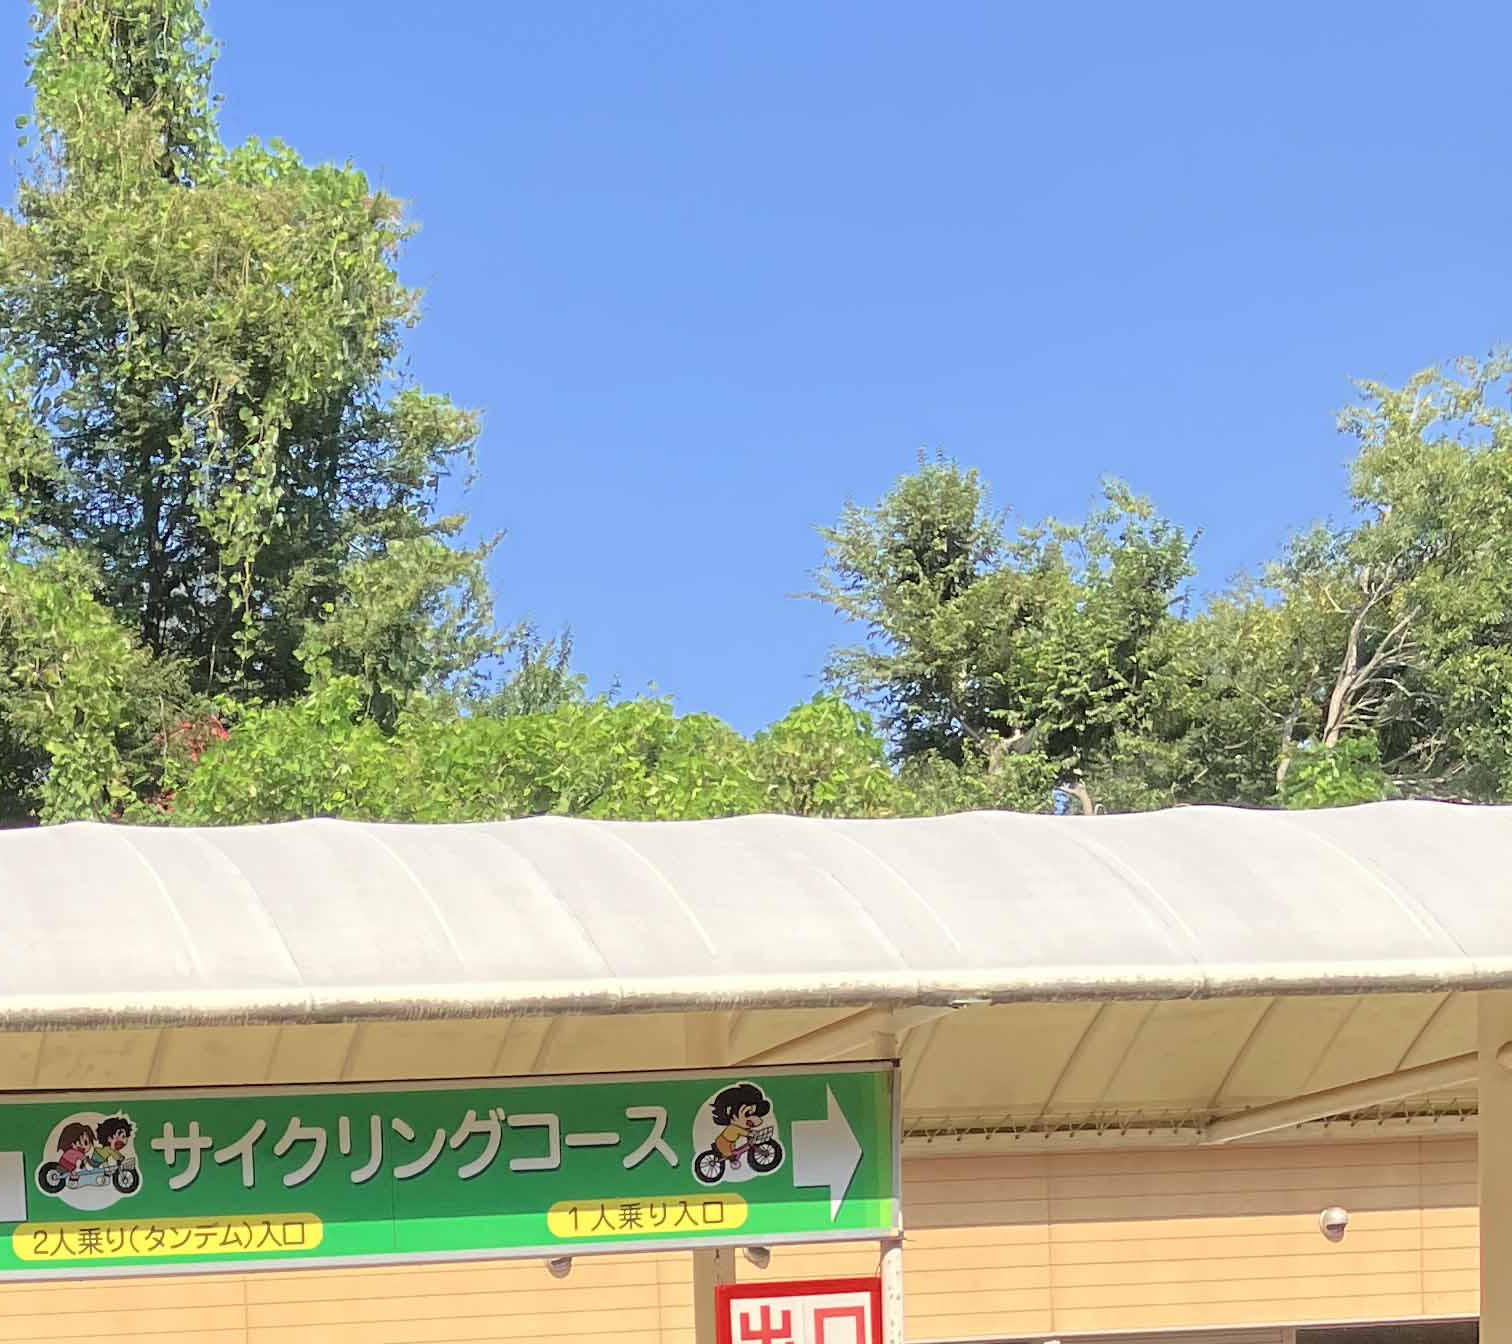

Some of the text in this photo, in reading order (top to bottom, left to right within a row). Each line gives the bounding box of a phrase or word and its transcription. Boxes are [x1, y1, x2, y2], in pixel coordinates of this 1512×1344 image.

[150, 1105, 680, 1190] サイクリングコース
[567, 1200, 725, 1232] 1人乗り入口
[32, 1220, 306, 1257] 2人乗り(タンデム)入口
